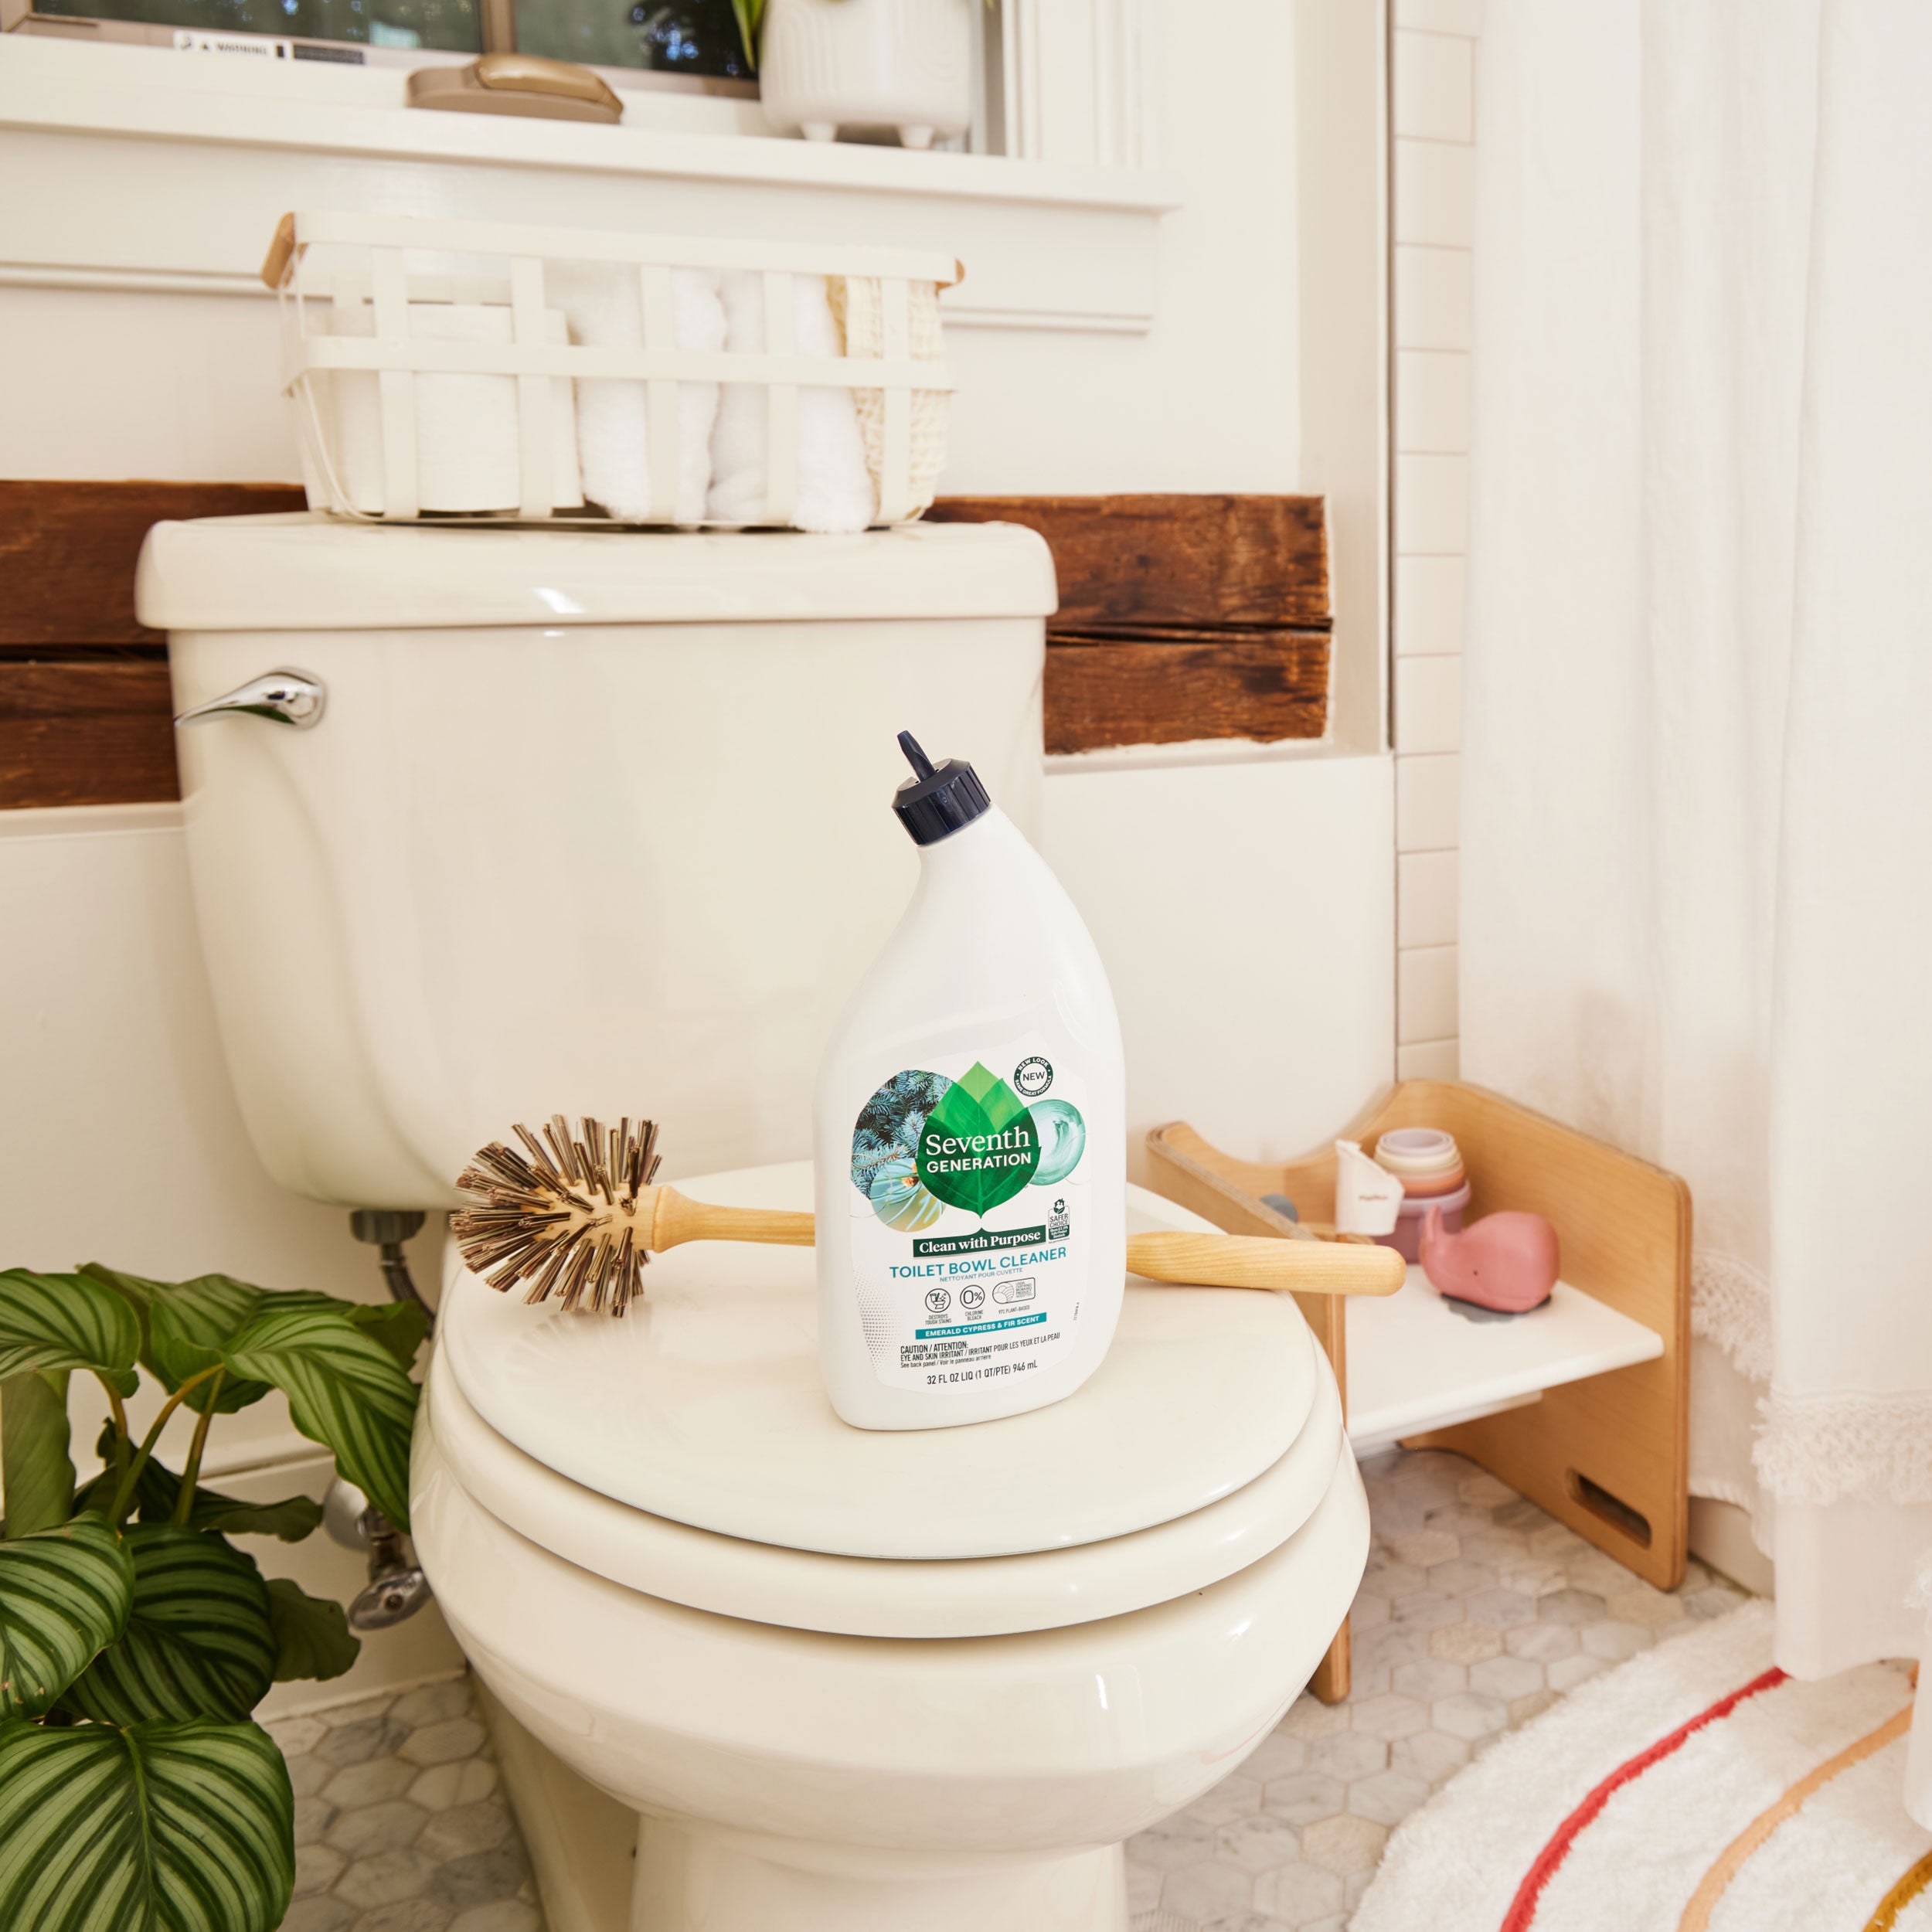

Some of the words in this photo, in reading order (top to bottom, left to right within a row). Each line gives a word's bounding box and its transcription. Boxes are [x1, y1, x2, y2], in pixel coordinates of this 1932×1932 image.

[1018, 1059, 1031, 1071] NEW
[1032, 1057, 1049, 1067] LOOK
[1022, 1071, 1046, 1081] NEW
[926, 1125, 1031, 1156] Seventh
[927, 1151, 1032, 1173] GENERATION
[1049, 1213, 1069, 1223] SAFER
[1049, 1219, 1069, 1228] CHOICE
[919, 1240, 957, 1253] Clean
[958, 1236, 988, 1250] with
[989, 1230, 1042, 1247] Purpose
[889, 1264, 945, 1279] TOILET
[948, 1258, 996, 1274] BOWL
[999, 1247, 1066, 1269] CLEANER
[939, 1274, 977, 1283] NETTOYANT
[996, 1267, 1023, 1276] CUVETTE
[963, 1290, 983, 1304] 0%
[1005, 1304, 1030, 1314] PLANT-BASED
[925, 1328, 961, 1337] EMERALD
[962, 1323, 995, 1333] CYPRESS
[1016, 1315, 1040, 1325] SCENT
[900, 1344, 928, 1354] CAUTION
[934, 1341, 968, 1352] ATTENTION:
[939, 1349, 964, 1359] IRRITANT
[968, 1345, 992, 1356] IRRITANT
[993, 1343, 1009, 1352] POUR
[1009, 1341, 1019, 1349] LES
[1020, 1338, 1033, 1347] YEUX
[1047, 1332, 1060, 1342] PEAU
[927, 1375, 937, 1385] 32
[938, 1374, 947, 1383] FL
[949, 1372, 959, 1383] OZ
[961, 1371, 973, 1381] LIQ
[975, 1369, 981, 1379] (1
[984, 1365, 1011, 1378] QT/PTE)
[1012, 1362, 1026, 1372] 946
[1027, 1359, 1038, 1369] mL
